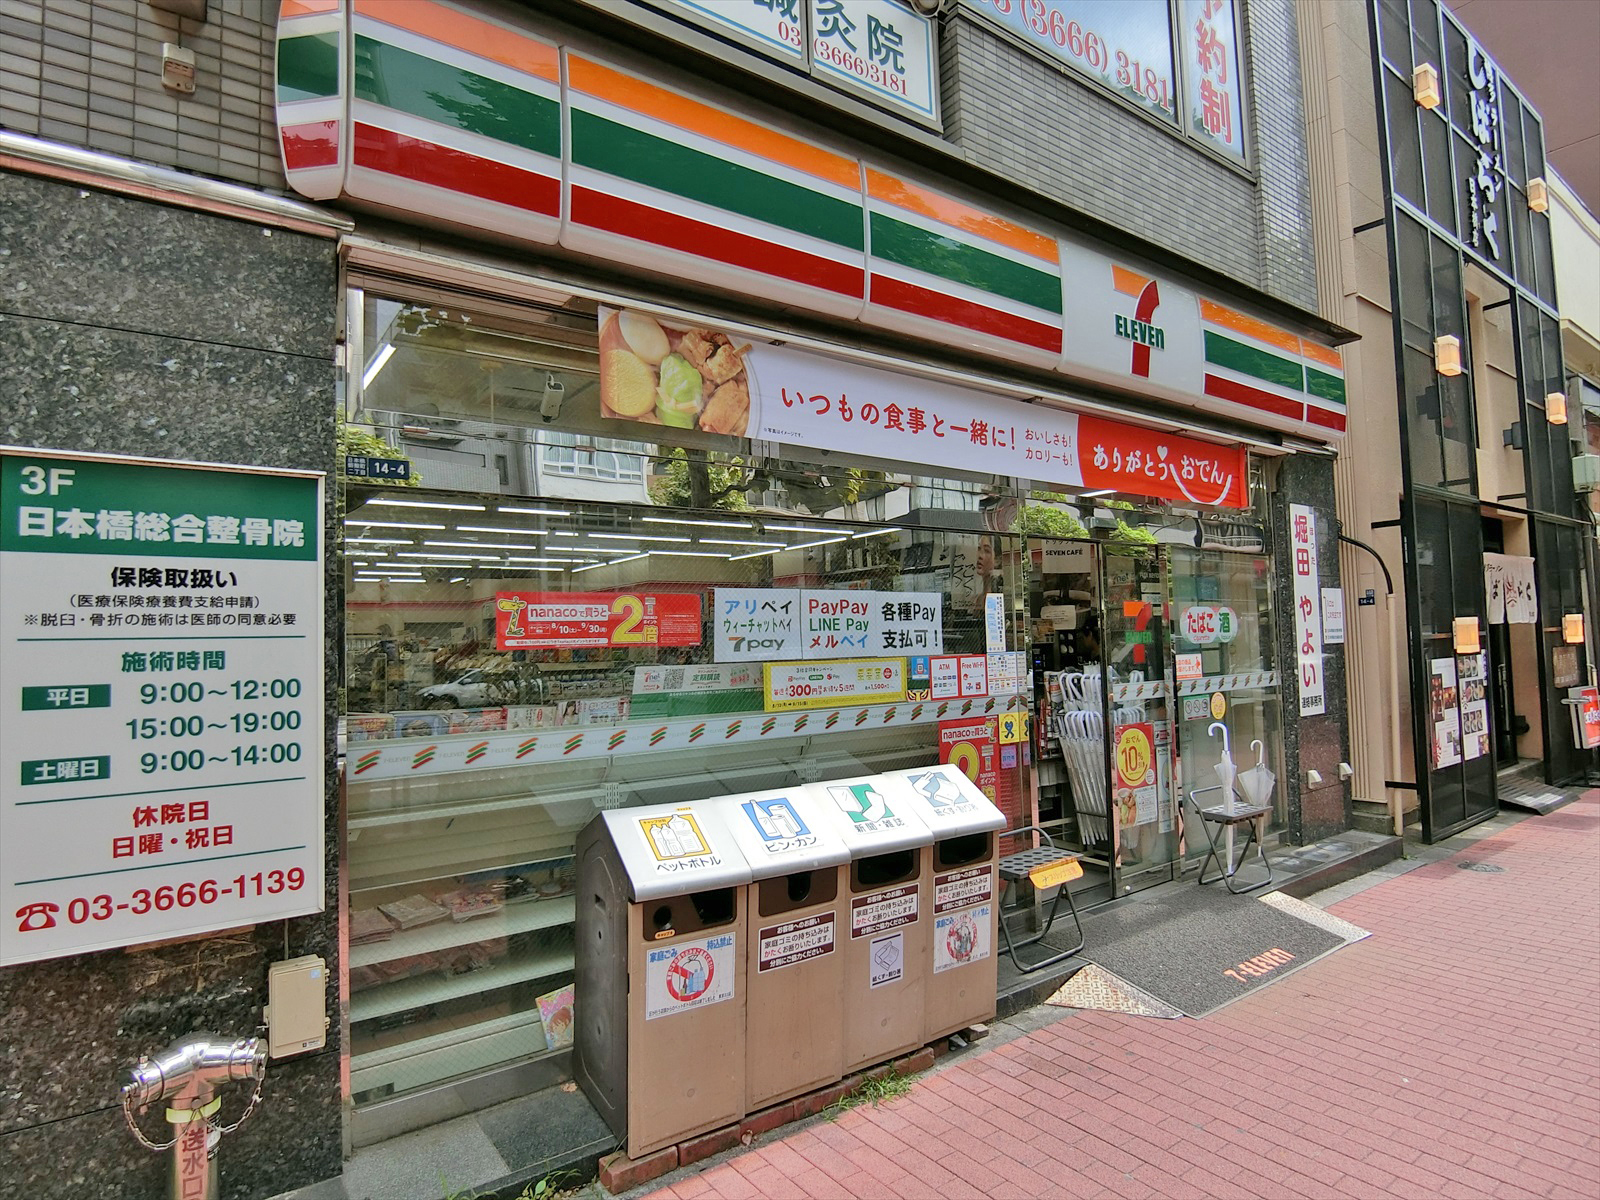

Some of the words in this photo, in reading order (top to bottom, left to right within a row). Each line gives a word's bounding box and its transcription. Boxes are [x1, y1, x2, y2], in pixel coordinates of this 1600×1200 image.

[1115, 48, 1172, 114] 3181
[374, 462, 405, 476] 14-4
[19, 466, 76, 496] 3F
[18, 507, 306, 547] 日本橋総合整骨院
[1294, 514, 1310, 577] 堀田
[111, 566, 238, 589] 保険取扱い
[530, 605, 608, 619] nanacoで買うと
[724, 599, 793, 615] アリペイ
[808, 599, 869, 616] PayPay
[881, 601, 936, 623] 各種Pay
[723, 617, 792, 634] ウィーチャットペイ
[809, 617, 840, 632] LINE
[846, 617, 870, 633] Pay
[1187, 611, 1214, 634] たばこ
[1218, 612, 1230, 633] 酒
[728, 636, 785, 653] 7pay
[808, 635, 868, 650] メルペイ
[1299, 595, 1317, 688] やよい
[121, 650, 226, 672] 施術時間
[938, 663, 951, 671] ATM
[47, 687, 90, 705] 平日
[34, 760, 100, 782] 土曜日
[132, 800, 210, 829] 休院日
[112, 824, 234, 859] 日曜・祝日
[68, 867, 306, 924] 03-3666-1139
[649, 947, 678, 963] 家庭ごみ
[706, 936, 733, 950] 持込禁止
[181, 1127, 206, 1198] 送水口
